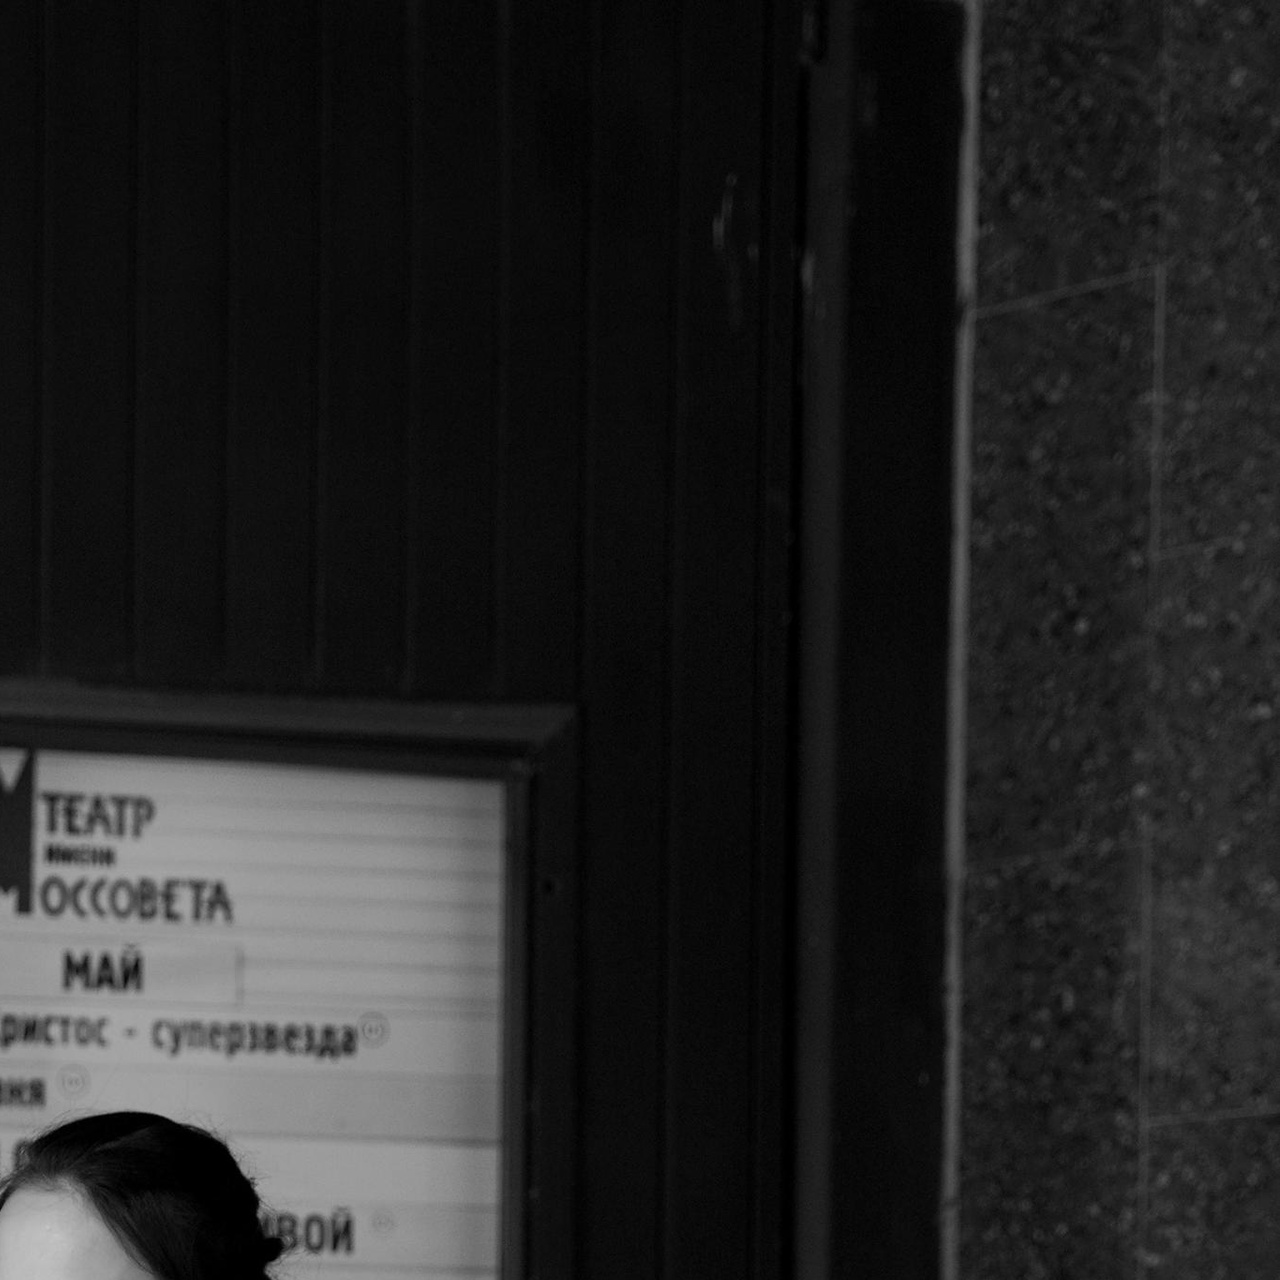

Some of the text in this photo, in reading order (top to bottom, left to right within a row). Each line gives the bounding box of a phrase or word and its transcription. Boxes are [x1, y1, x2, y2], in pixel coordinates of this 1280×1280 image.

[41, 791, 157, 838] ТЕАТР
[62, 944, 143, 991] МАЙ
[151, 1017, 359, 1061] суперзвезда
